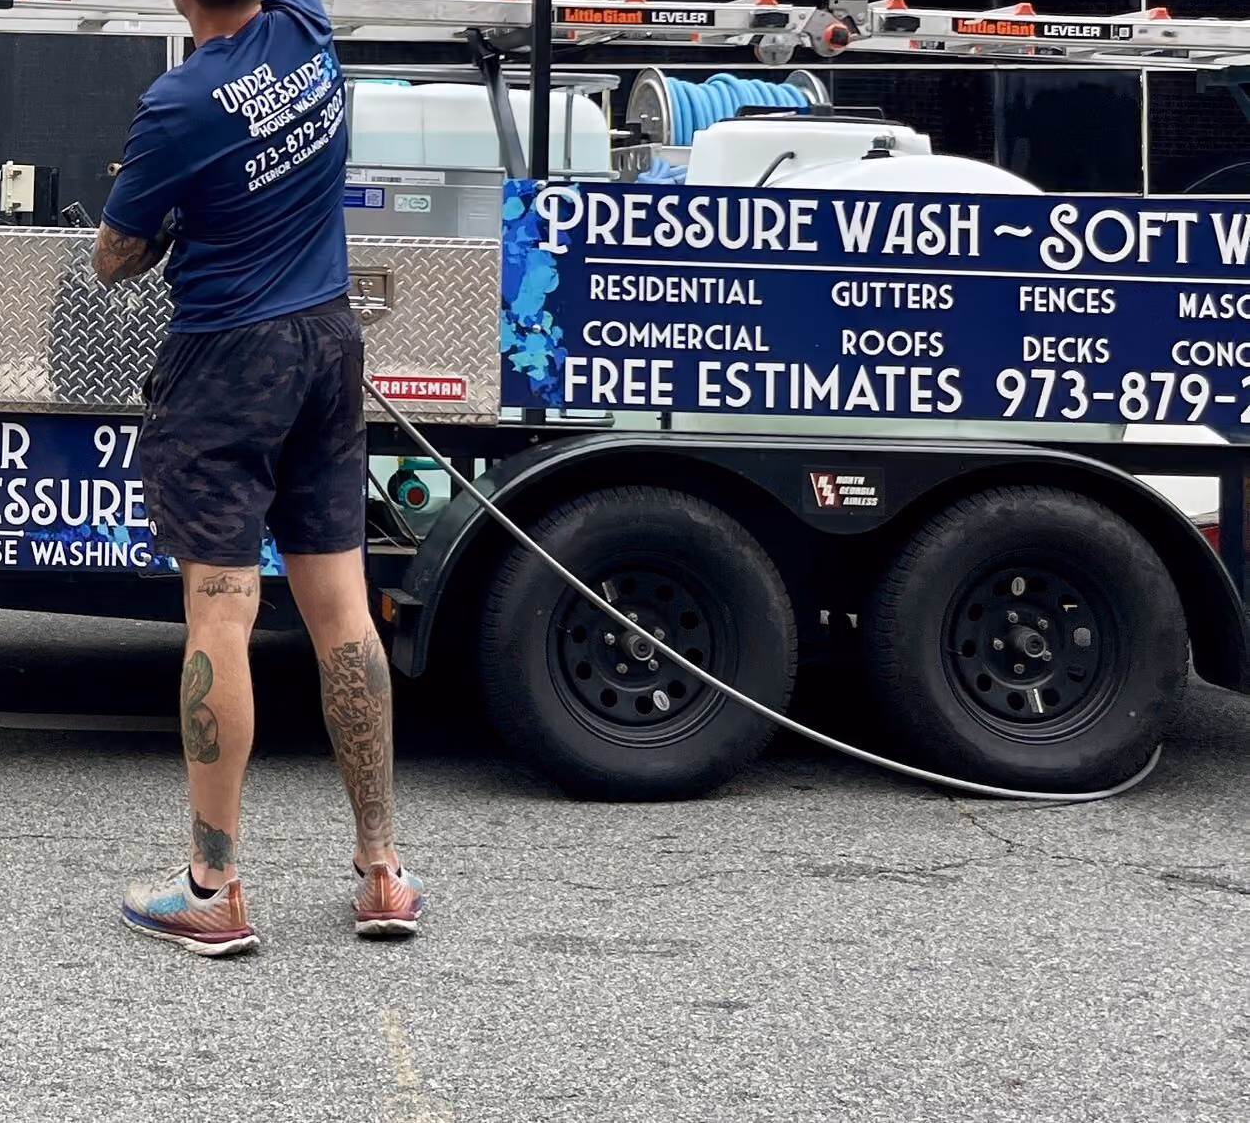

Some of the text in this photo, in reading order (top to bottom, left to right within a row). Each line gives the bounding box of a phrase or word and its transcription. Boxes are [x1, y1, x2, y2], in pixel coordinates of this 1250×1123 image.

[652, 11, 708, 24] LEVELER
[1044, 25, 1100, 37] LEVELER
[212, 63, 276, 114] UNDER
[241, 53, 323, 129] PRESSURE
[260, 80, 332, 138] HOUSE WASHING
[245, 88, 343, 178] 973-879-2007
[248, 161, 291, 192] EXTERIOR
[292, 133, 329, 165] CLEANING
[536, 186, 818, 254] PRESSURE
[831, 200, 980, 256] WASH
[1039, 203, 1198, 271] SOFT
[590, 274, 763, 306] RESIDENTIAL
[831, 281, 953, 309] GUTTERS
[1019, 285, 1115, 314] FENCES
[582, 321, 769, 352] COMMERCIAL
[841, 329, 944, 358] ROOFS
[1023, 335, 1110, 364] DECKS
[372, 380, 462, 396] CRAFTSMAN
[564, 356, 673, 406] FREE
[698, 361, 962, 414] ESTIMATES
[836, 476, 865, 485] NORTH
[839, 486, 875, 496] GEORGIA
[843, 497, 878, 506] AIRLESS
[31, 541, 150, 567] WASHING
